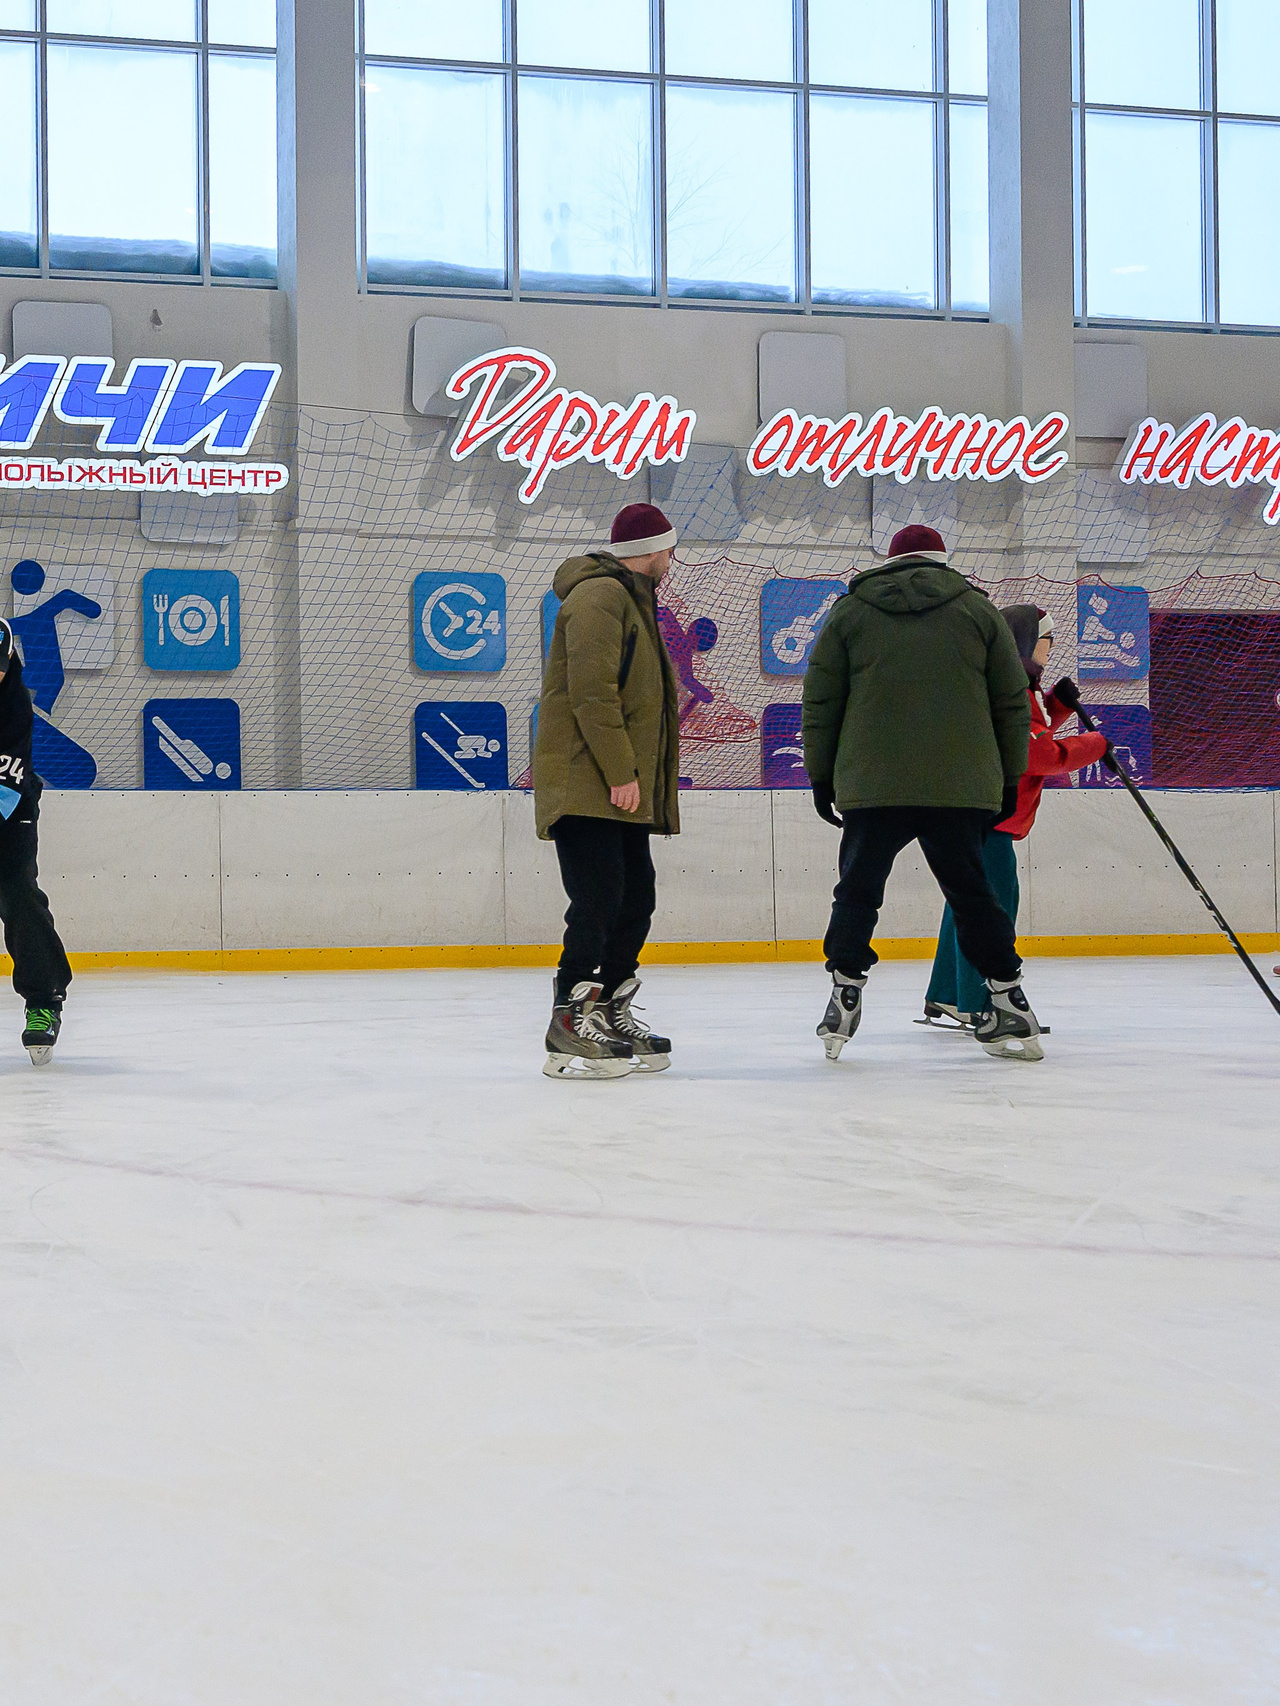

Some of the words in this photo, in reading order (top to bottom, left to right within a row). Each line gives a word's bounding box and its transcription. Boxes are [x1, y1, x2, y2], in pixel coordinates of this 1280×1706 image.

[451, 352, 691, 498] Дарим
[751, 411, 1065, 483] отличное
[1123, 418, 1280, 519] наст
[187, 467, 283, 490] ЦЕНТР
[465, 608, 502, 636] 24
